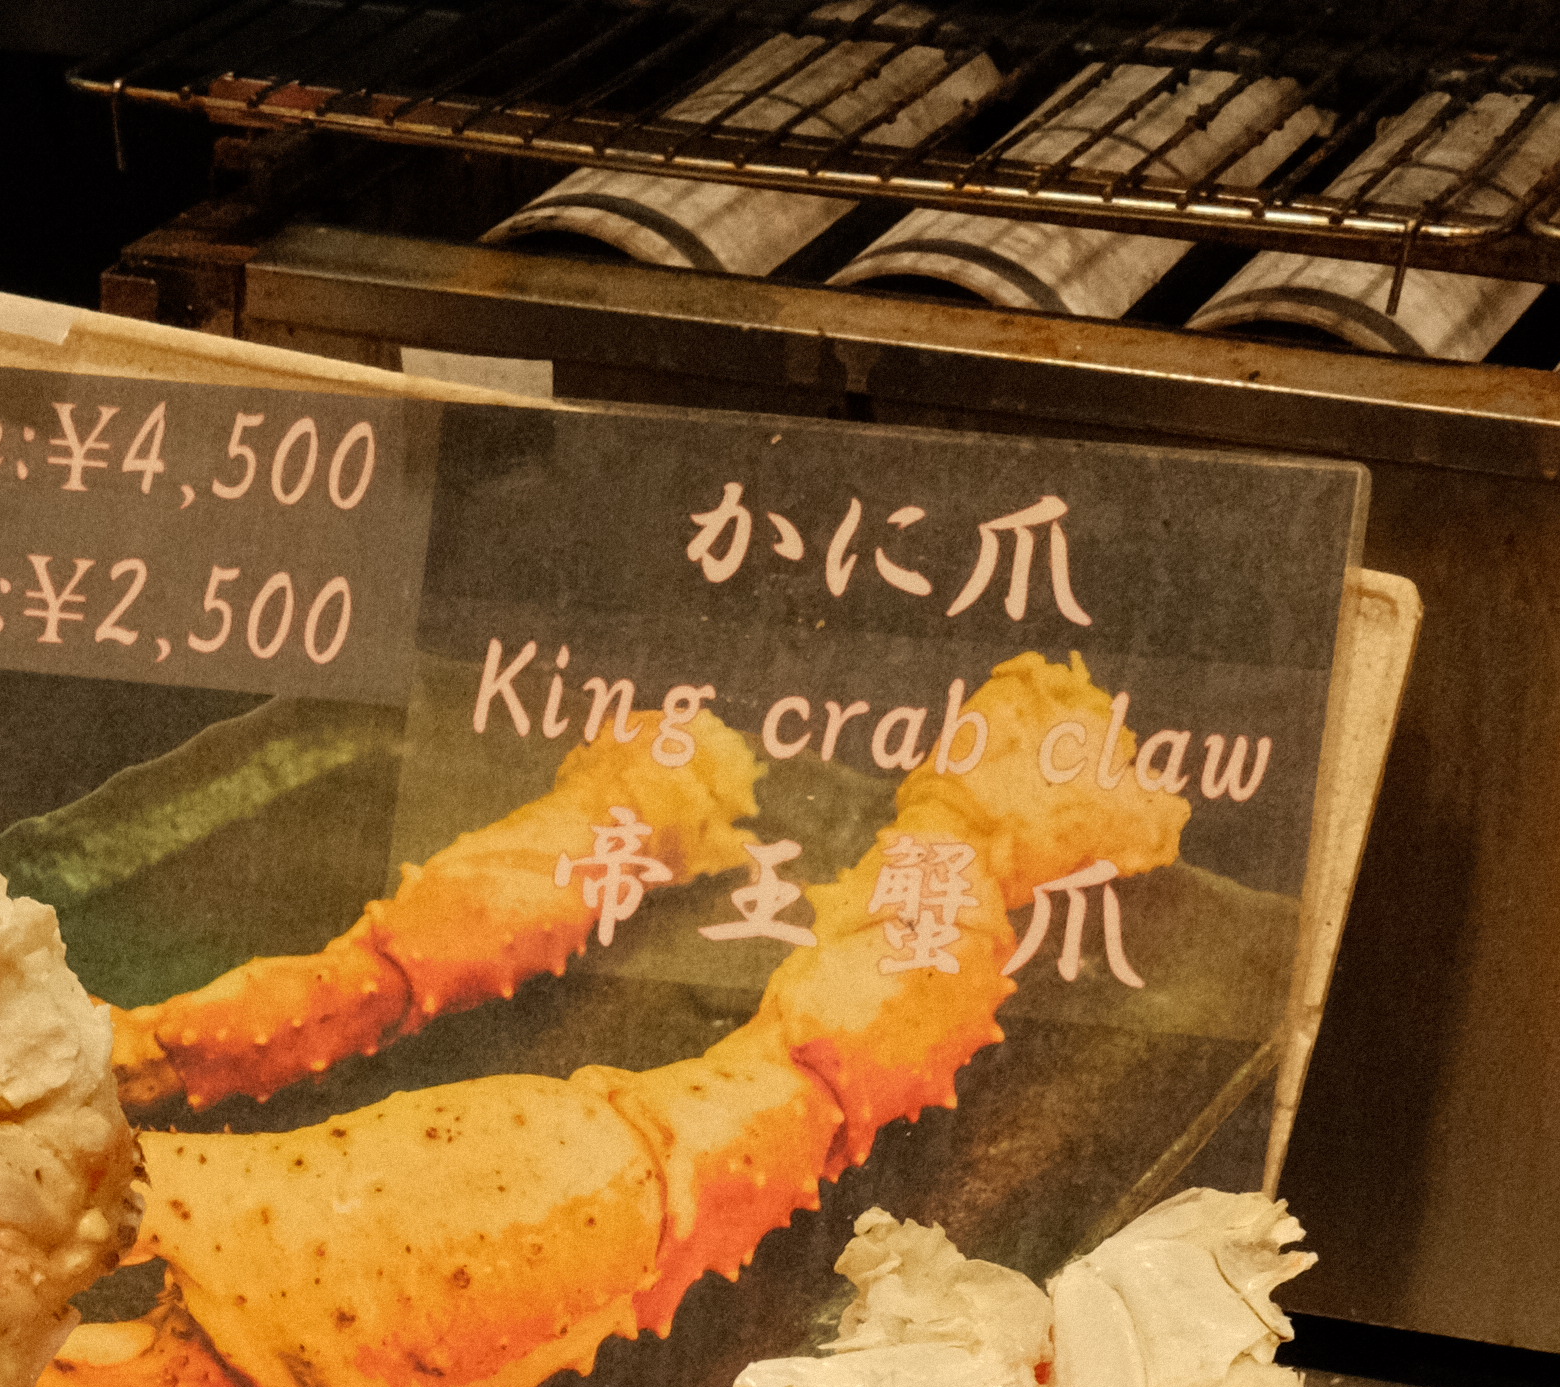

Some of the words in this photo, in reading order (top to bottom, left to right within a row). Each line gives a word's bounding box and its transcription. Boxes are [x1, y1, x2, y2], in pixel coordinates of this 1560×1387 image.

[686, 480, 1093, 627] かに爪
[472, 638, 716, 768] King
[761, 677, 991, 777] crab
[1037, 691, 1273, 802] claw
[553, 804, 1145, 989] 帝王蟹爪
